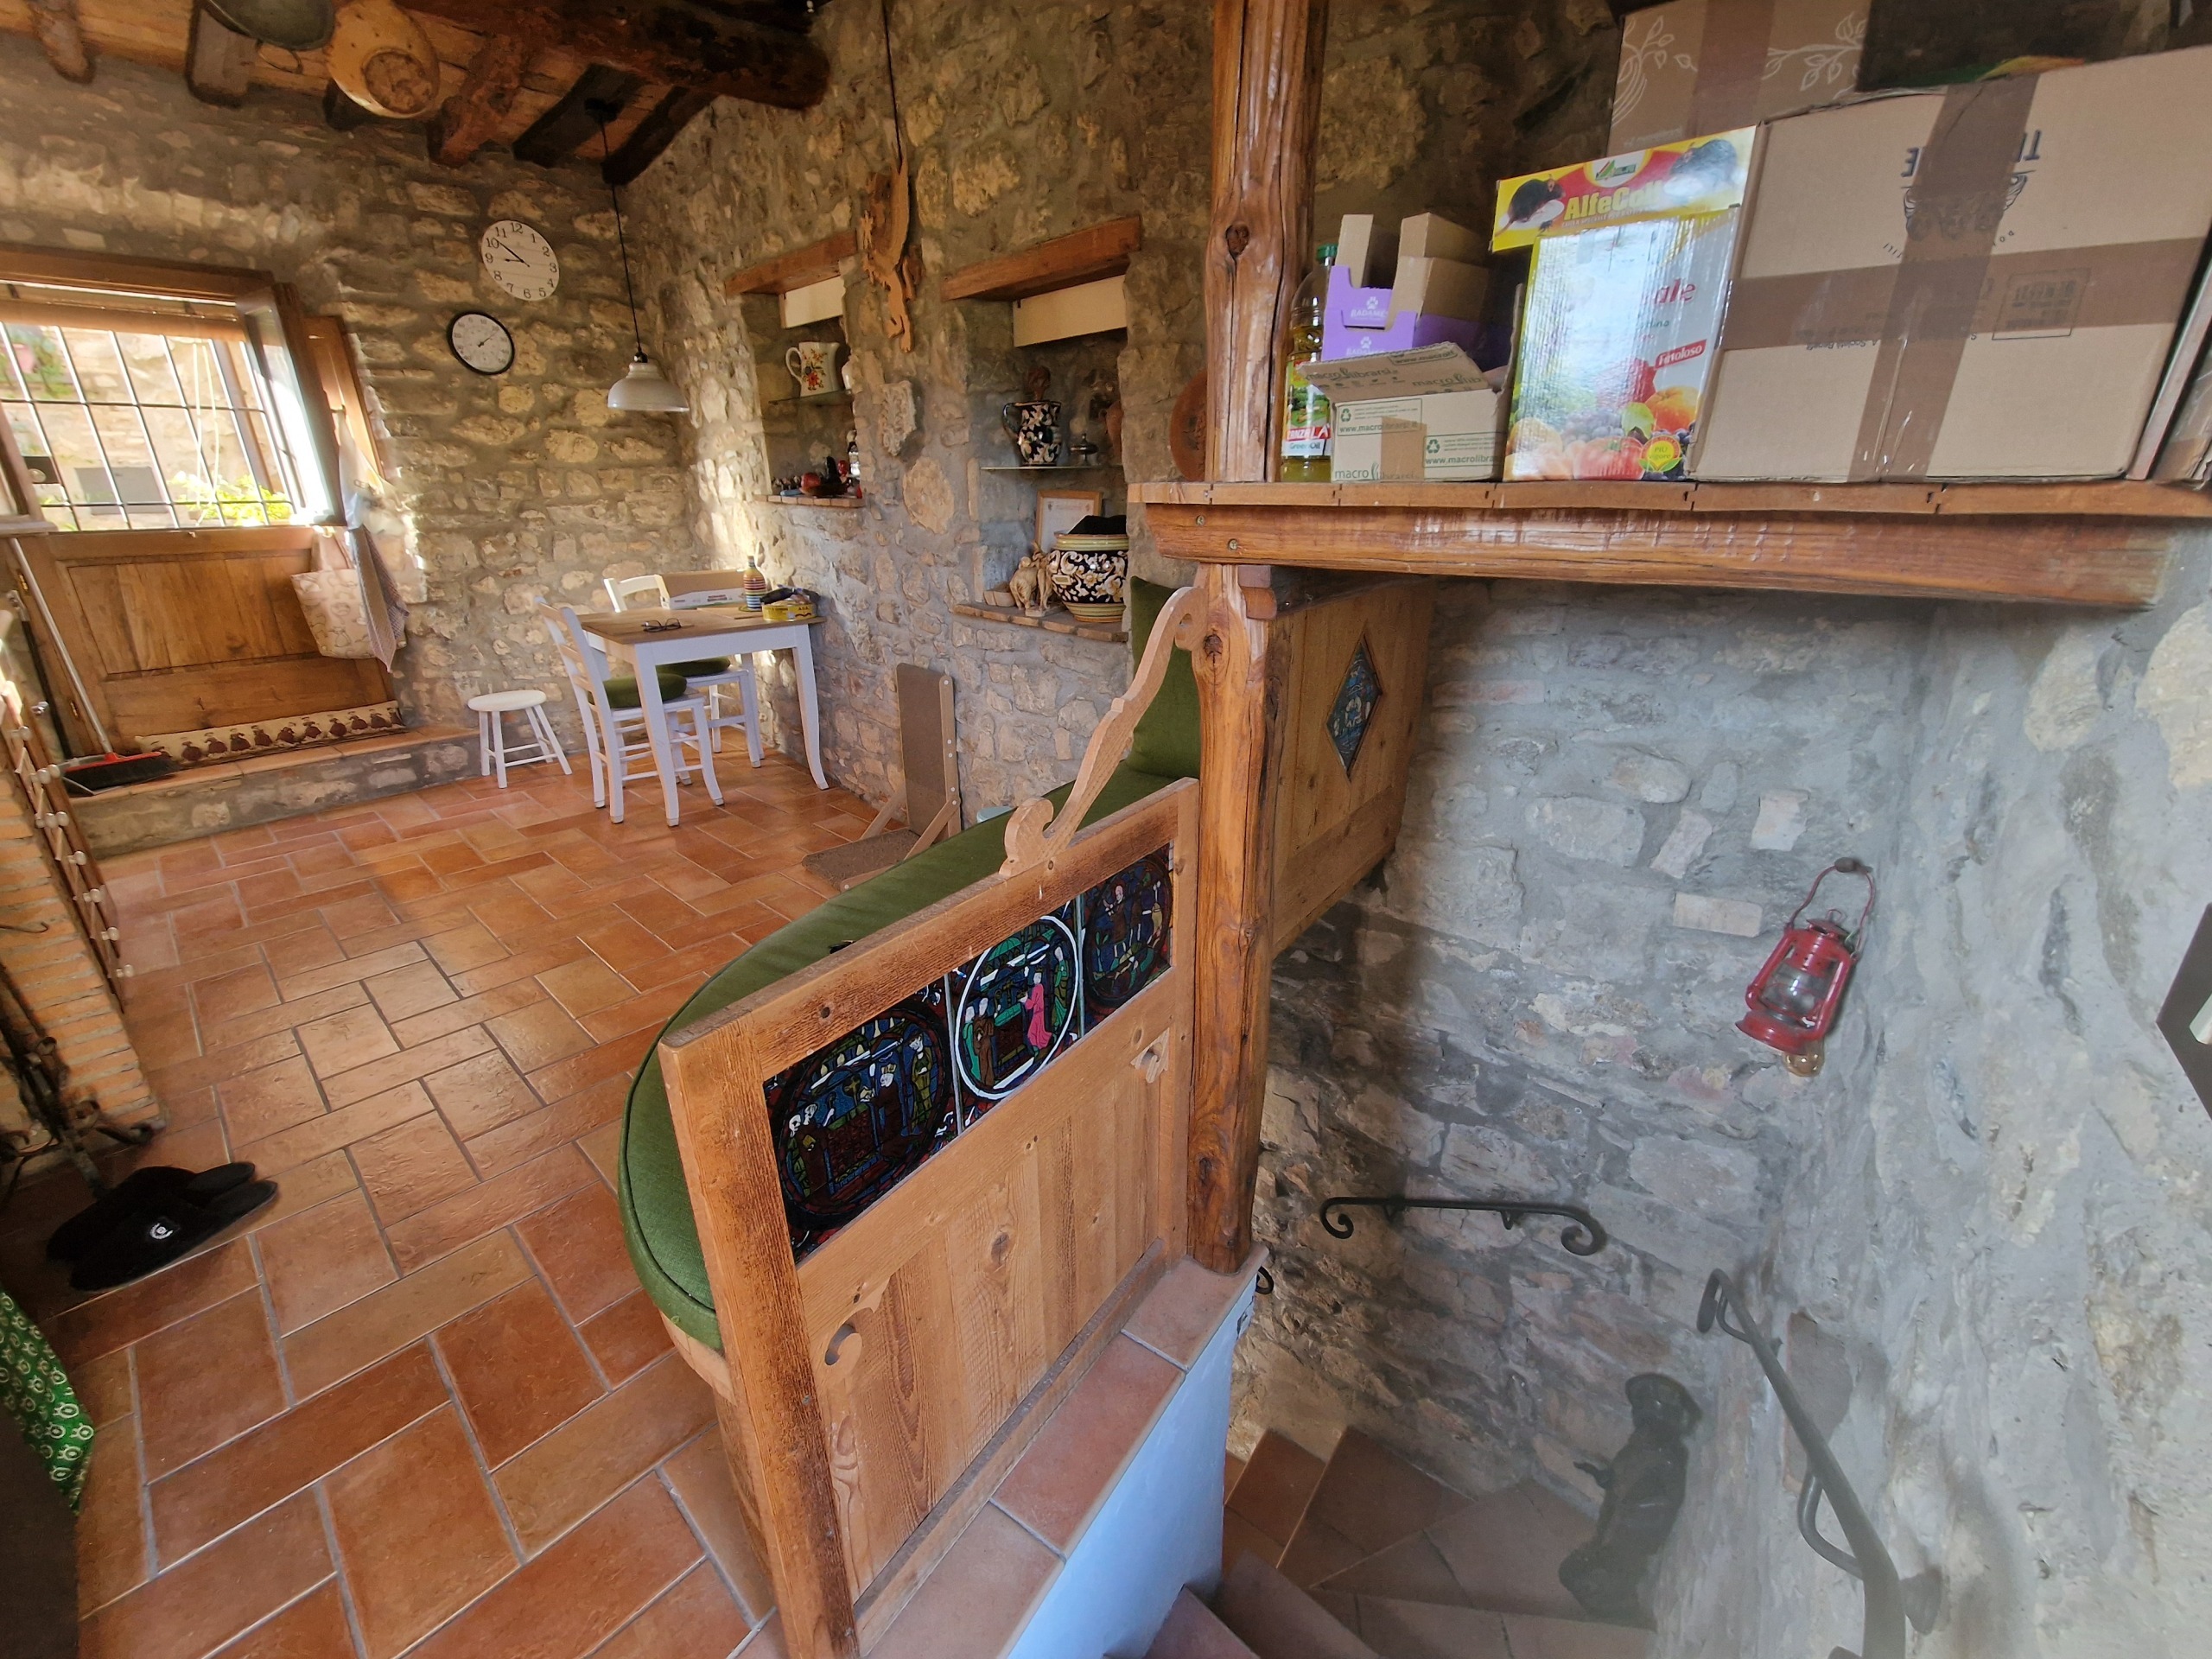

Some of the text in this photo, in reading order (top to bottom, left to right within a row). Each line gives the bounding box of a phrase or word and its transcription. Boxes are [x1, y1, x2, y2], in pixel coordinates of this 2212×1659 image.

[495, 226, 507, 238] 11
[511, 222, 524, 234] 12
[486, 238, 499, 249] 10
[531, 233, 536, 243] 1
[542, 245, 550, 257] 2
[485, 252, 493, 264] 9
[550, 262, 557, 273] 3
[493, 270, 502, 281] 8
[506, 283, 514, 292] 7
[547, 278, 554, 288] 4
[524, 289, 531, 299] 6
[538, 287, 546, 297] 5
